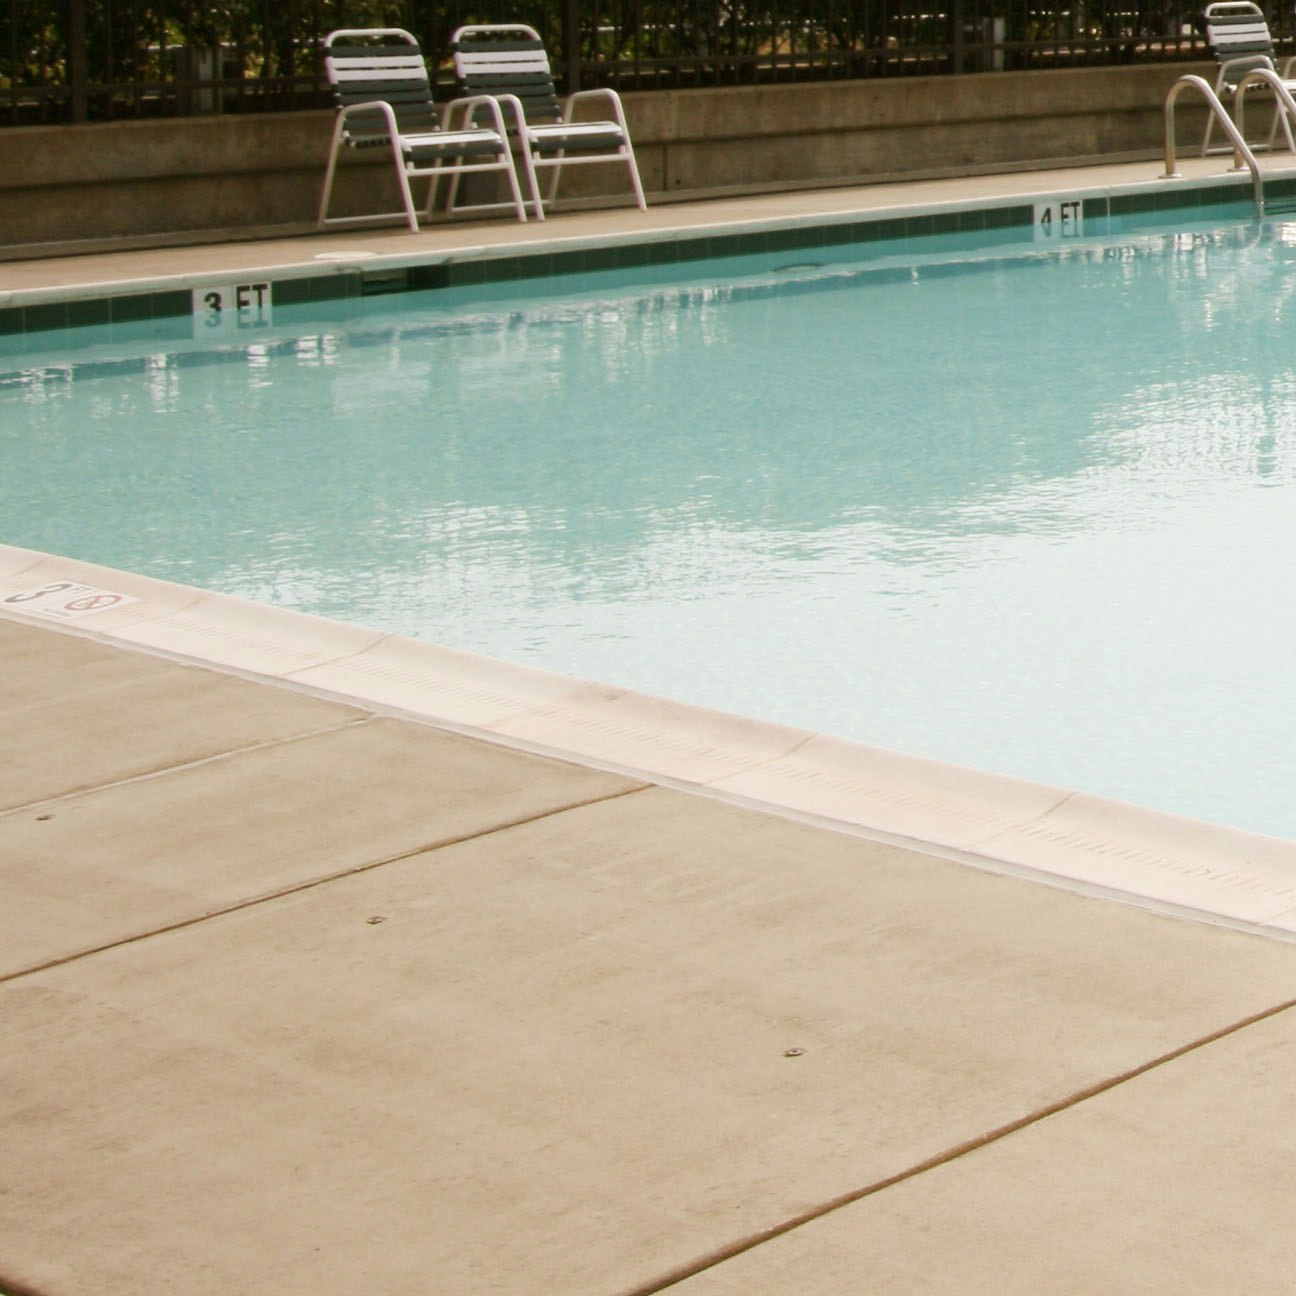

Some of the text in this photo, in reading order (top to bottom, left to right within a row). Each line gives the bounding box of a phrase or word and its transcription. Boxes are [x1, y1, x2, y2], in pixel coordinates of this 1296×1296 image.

[1040, 201, 1080, 224] 4 FT
[204, 284, 268, 313] 3 FT
